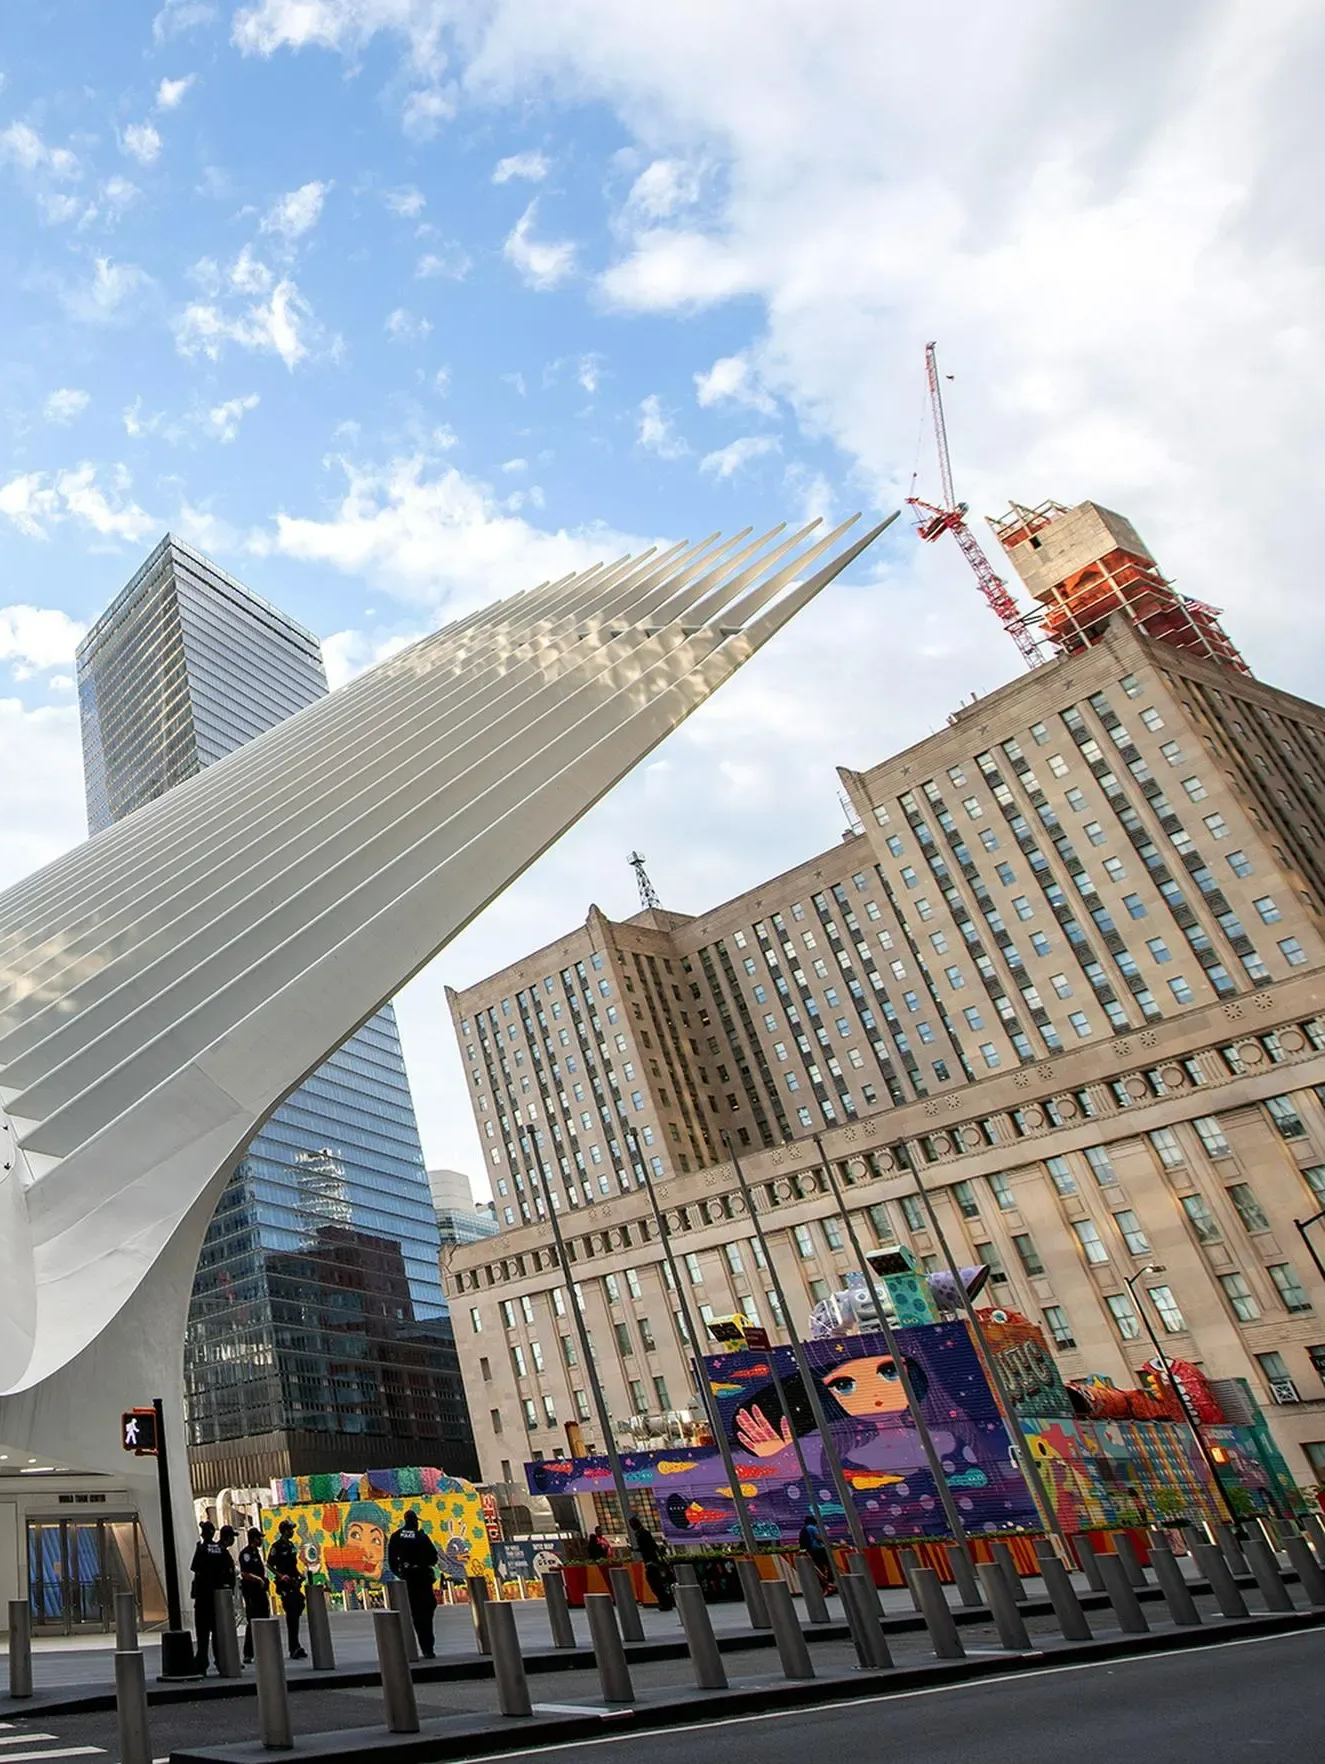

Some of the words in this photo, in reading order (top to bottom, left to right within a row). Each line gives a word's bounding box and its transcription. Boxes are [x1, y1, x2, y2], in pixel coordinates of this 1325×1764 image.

[58, 1495, 74, 1504] WORLD
[75, 1494, 88, 1503] TRADE
[89, 1494, 106, 1503] CENTER
